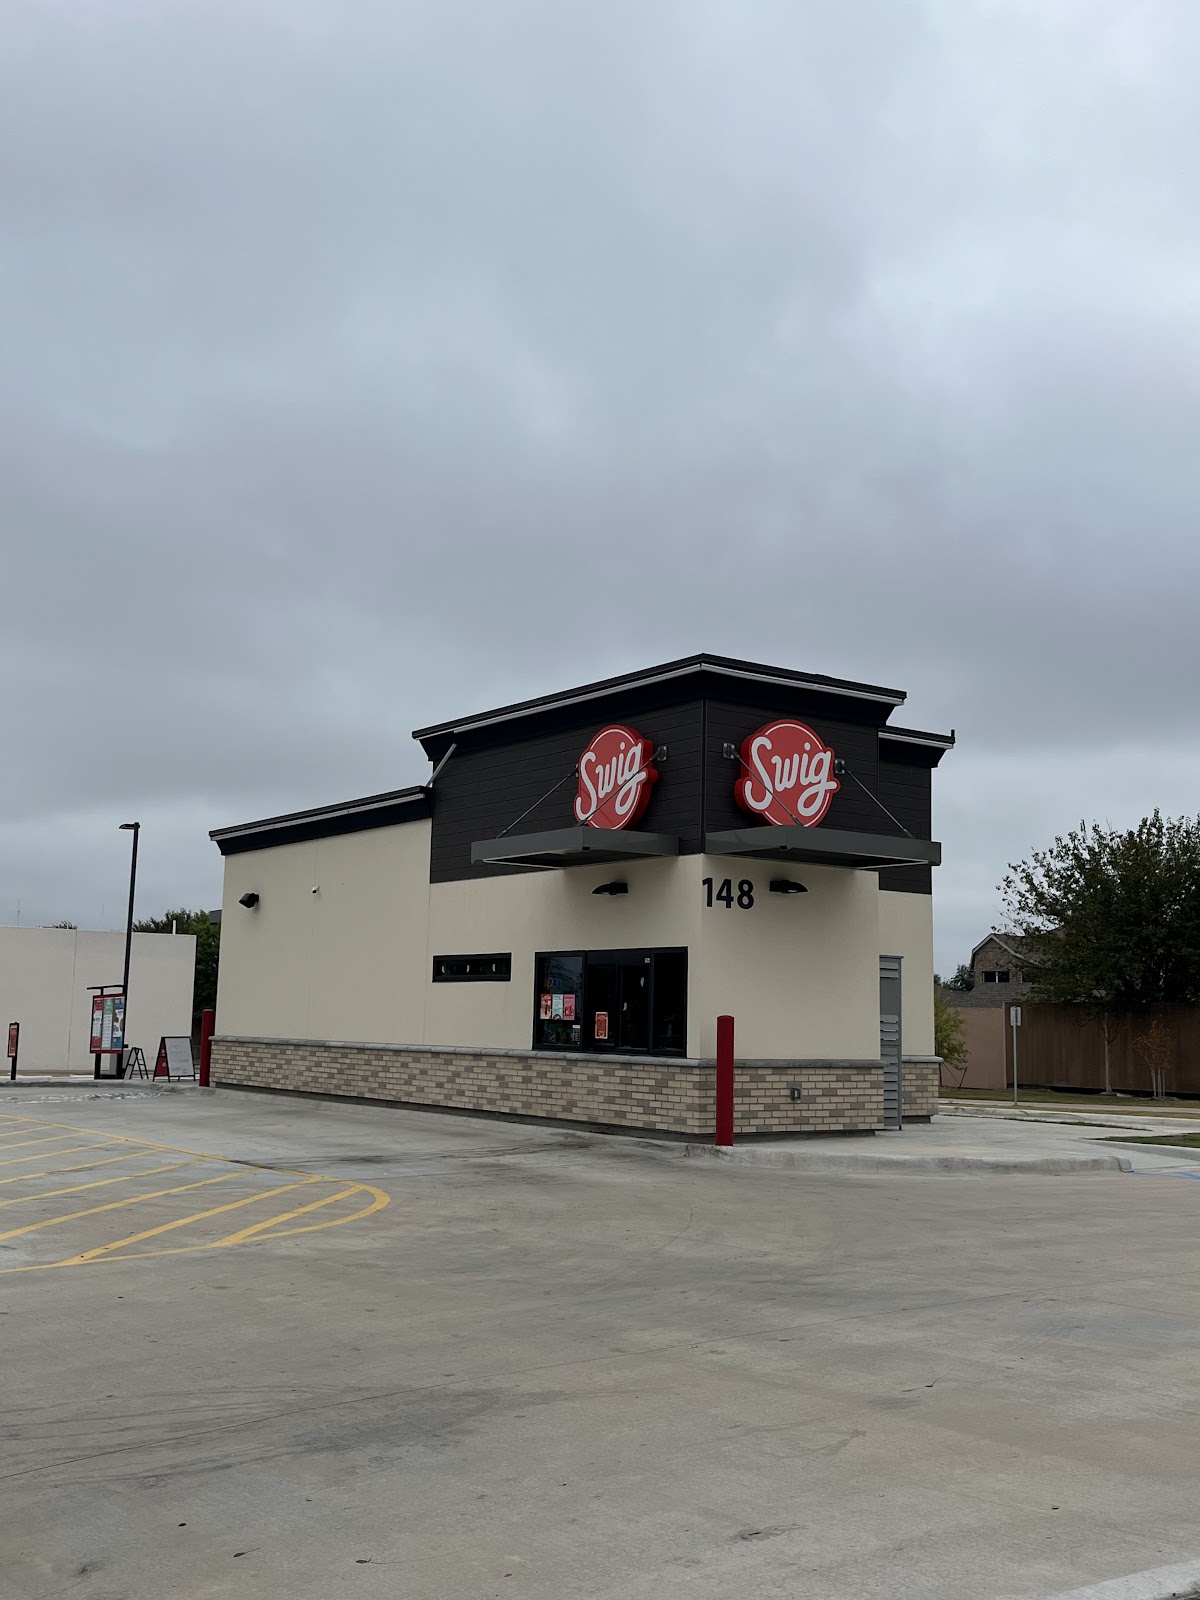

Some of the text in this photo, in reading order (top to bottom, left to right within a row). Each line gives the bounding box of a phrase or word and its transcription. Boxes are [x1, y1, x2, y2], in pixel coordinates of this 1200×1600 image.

[576, 742, 646, 821] Swig
[745, 736, 837, 816] Swig
[702, 877, 754, 909] 148
